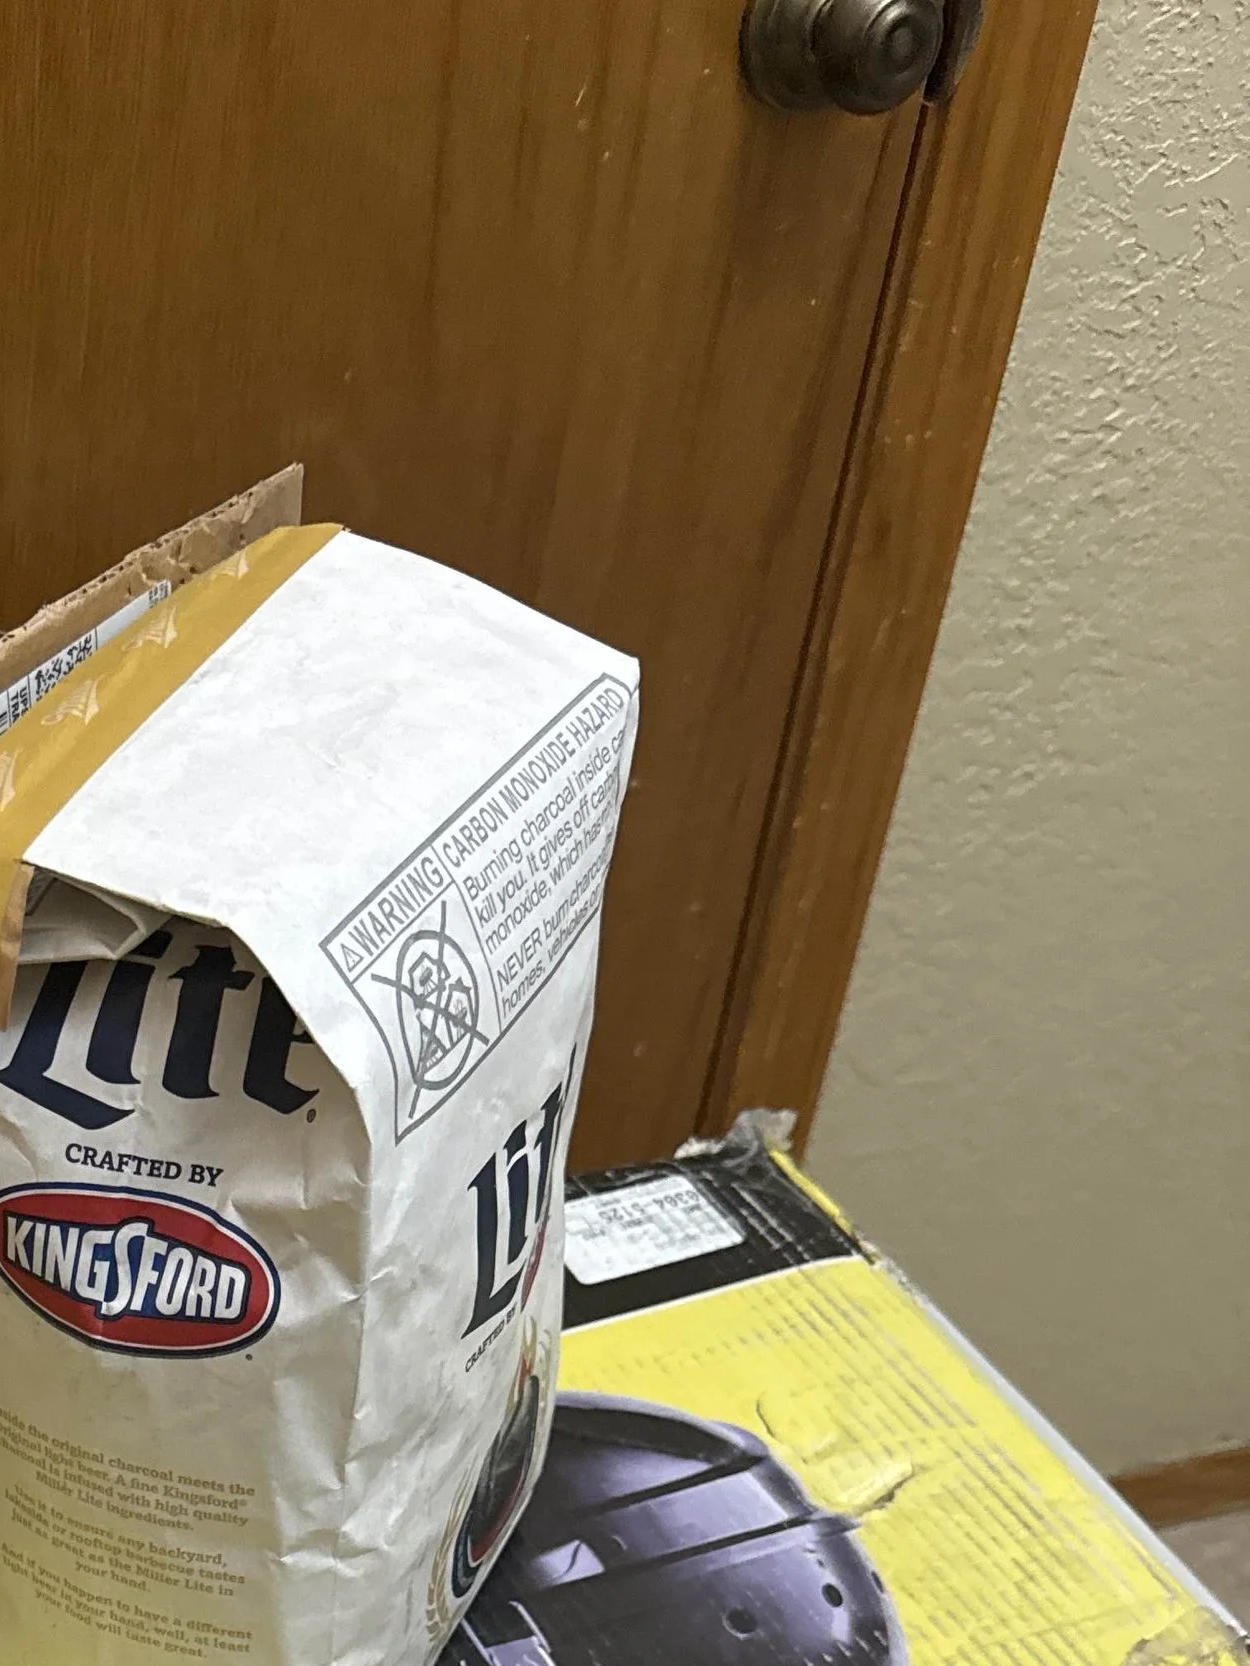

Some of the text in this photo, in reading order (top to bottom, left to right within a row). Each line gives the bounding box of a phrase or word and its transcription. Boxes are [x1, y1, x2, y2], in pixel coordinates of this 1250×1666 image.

[349, 687, 624, 958] WARNING CARBON MONOXIDE HAZARD
[463, 839, 523, 900] Burning
[521, 778, 576, 846] charcoal
[573, 746, 611, 792] inside
[475, 891, 497, 928] kill
[497, 870, 528, 914] you.
[526, 852, 539, 877] It
[539, 821, 573, 871] gives
[573, 794, 590, 829] off
[485, 880, 551, 954] monoxide,
[550, 839, 582, 886] which
[497, 927, 542, 992] NEVER
[502, 960, 546, 1018] homes,
[65, 1143, 225, 1188] CRAFTED BY
[5, 1214, 247, 1320] KINGSFORD
[465, 1318, 505, 1373] CRAFTED
